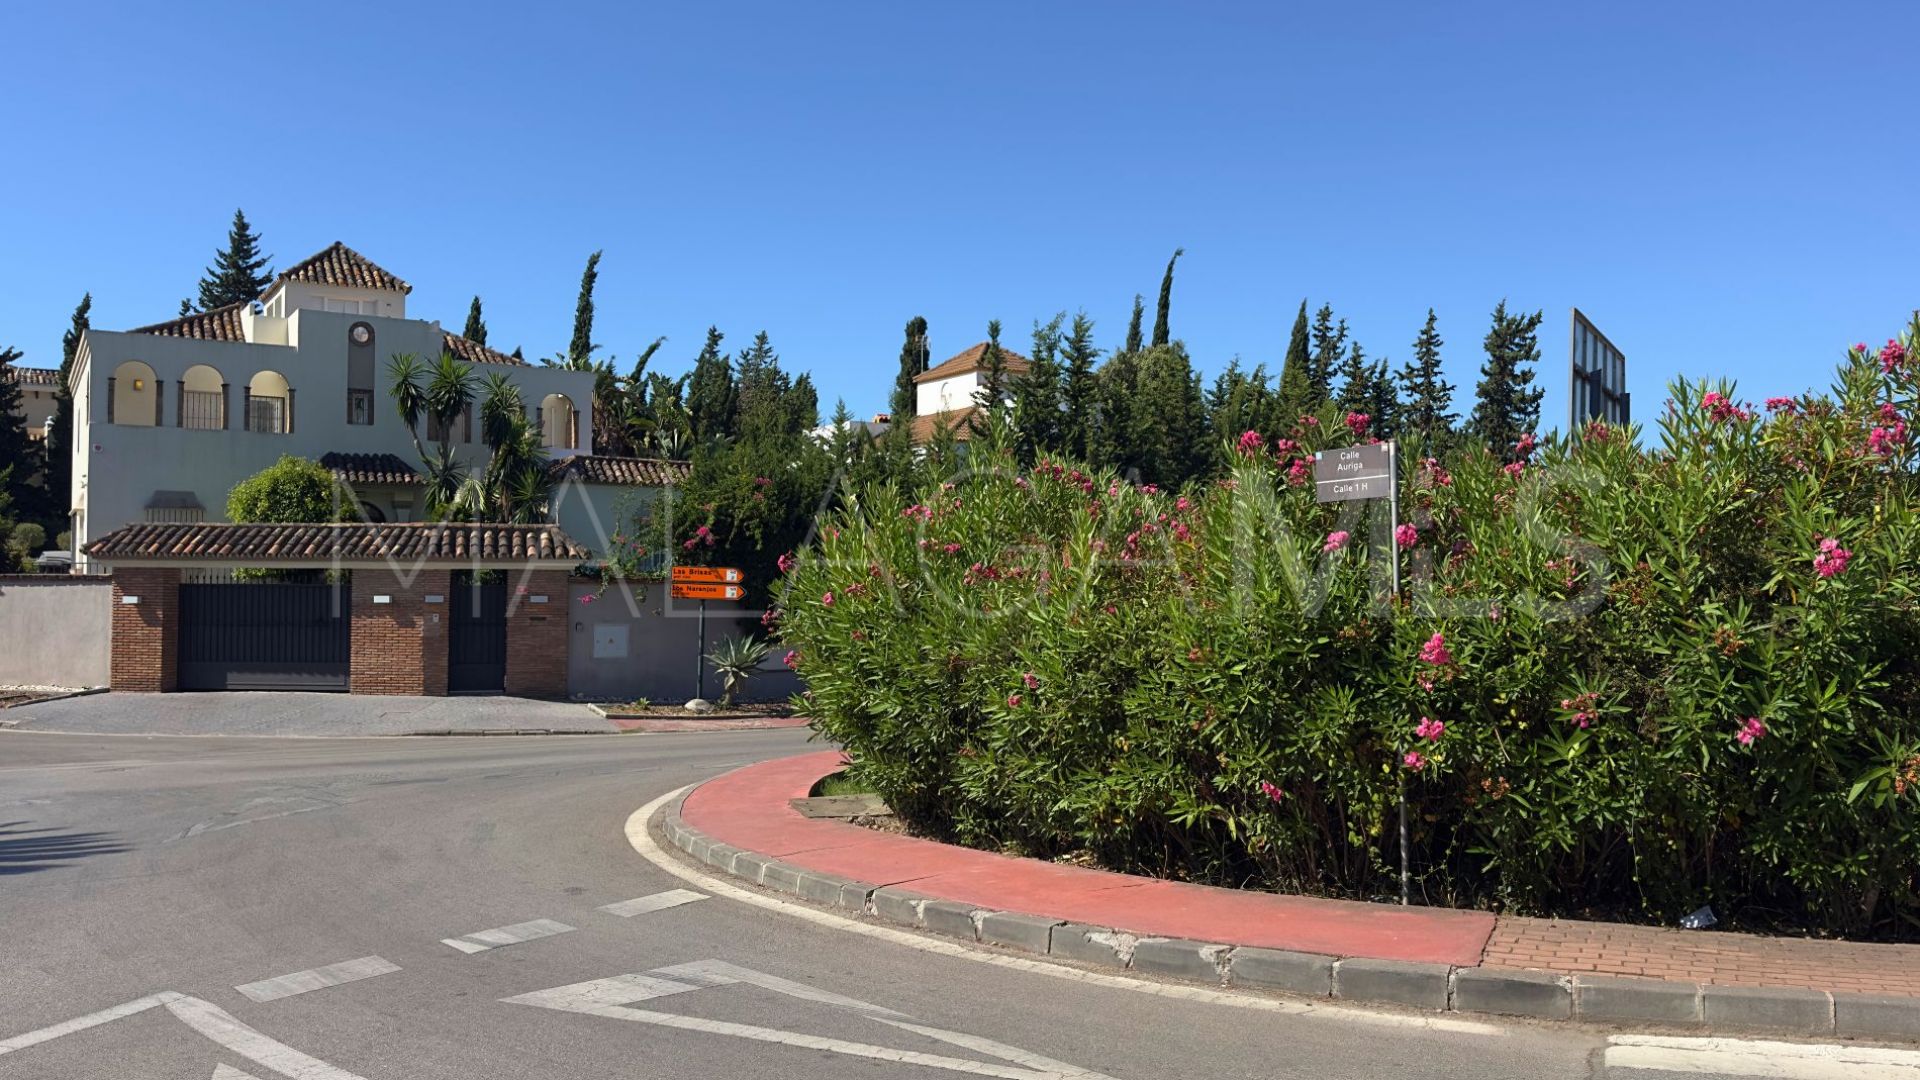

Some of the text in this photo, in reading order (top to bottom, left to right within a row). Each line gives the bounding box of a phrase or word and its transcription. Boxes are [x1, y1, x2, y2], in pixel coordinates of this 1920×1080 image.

[1340, 451, 1360, 461] Calle
[1337, 462, 1363, 472] Auriga
[1333, 482, 1368, 493] Calle 1 H
